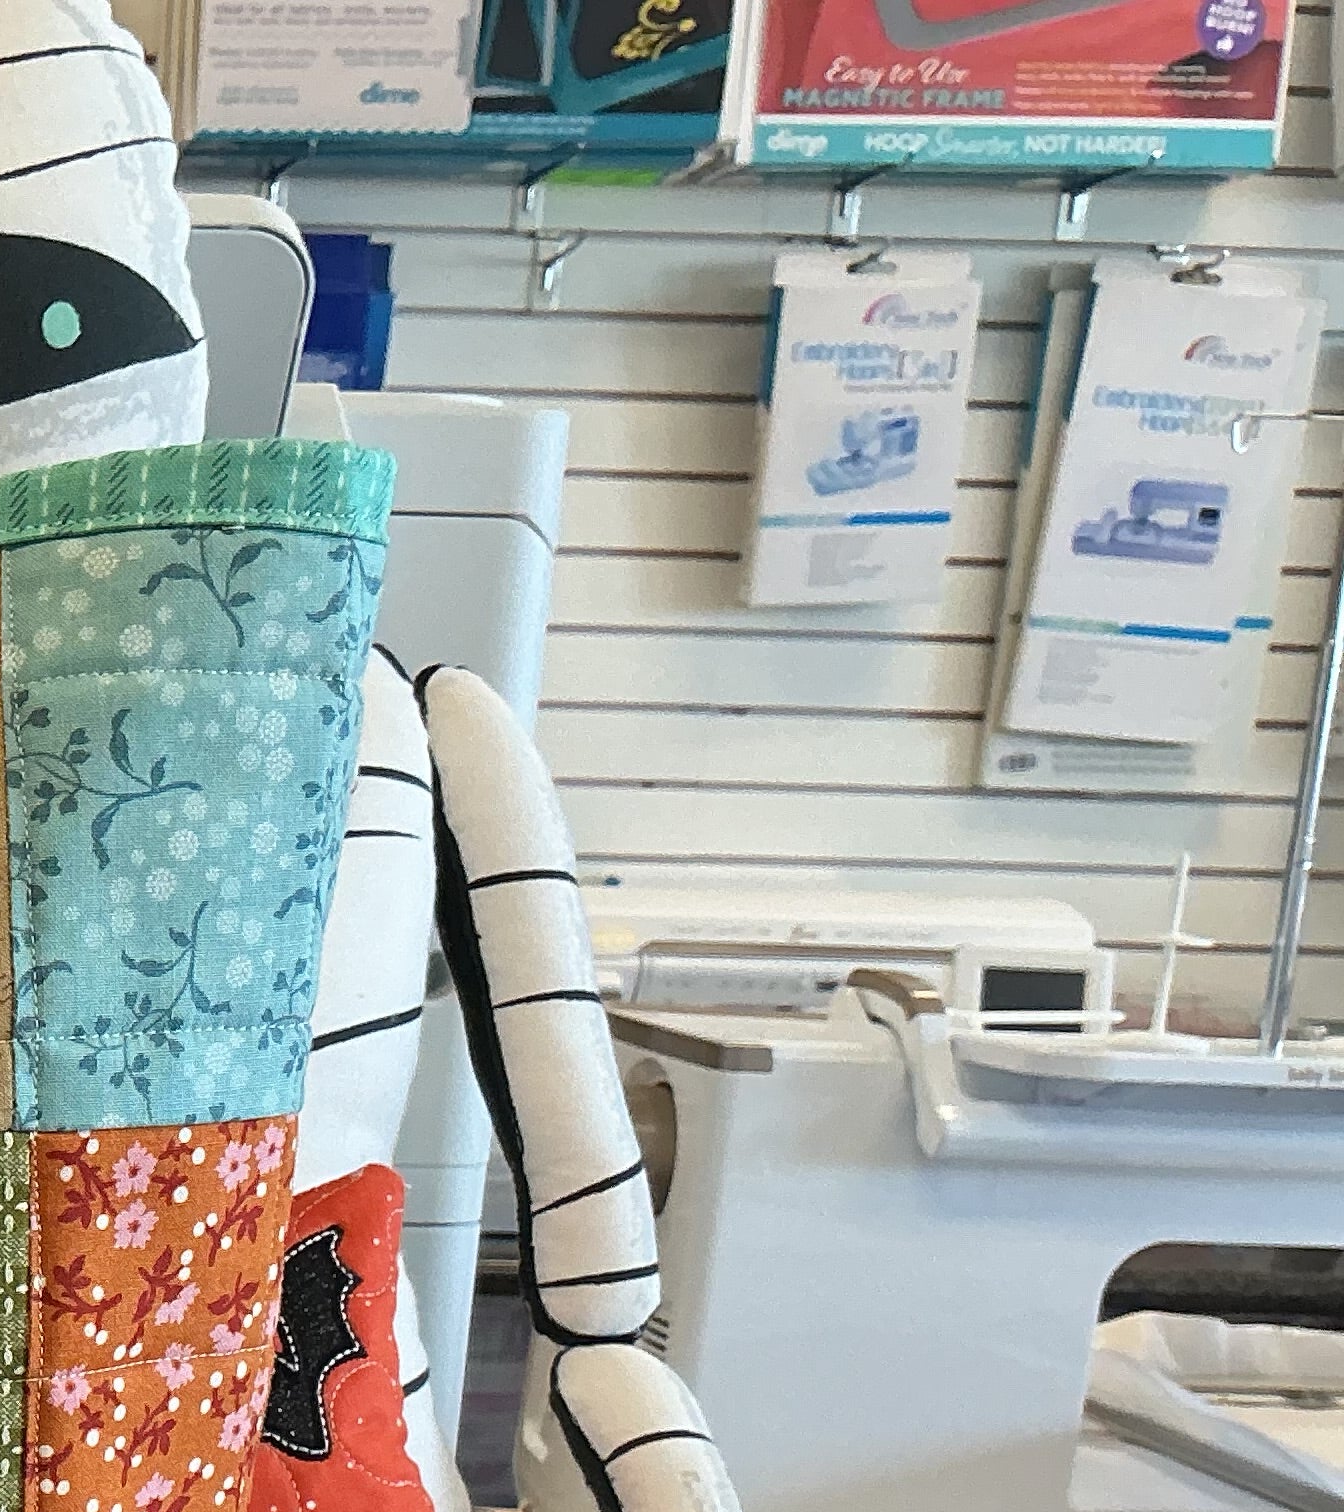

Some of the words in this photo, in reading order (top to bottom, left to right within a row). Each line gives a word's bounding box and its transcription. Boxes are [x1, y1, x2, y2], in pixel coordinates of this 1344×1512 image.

[824, 54, 884, 94] Easy
[782, 87, 915, 108] MAGNETIC
[922, 88, 1006, 109] FRAME
[864, 132, 929, 153] HOOP
[1023, 133, 1071, 154] NOT
